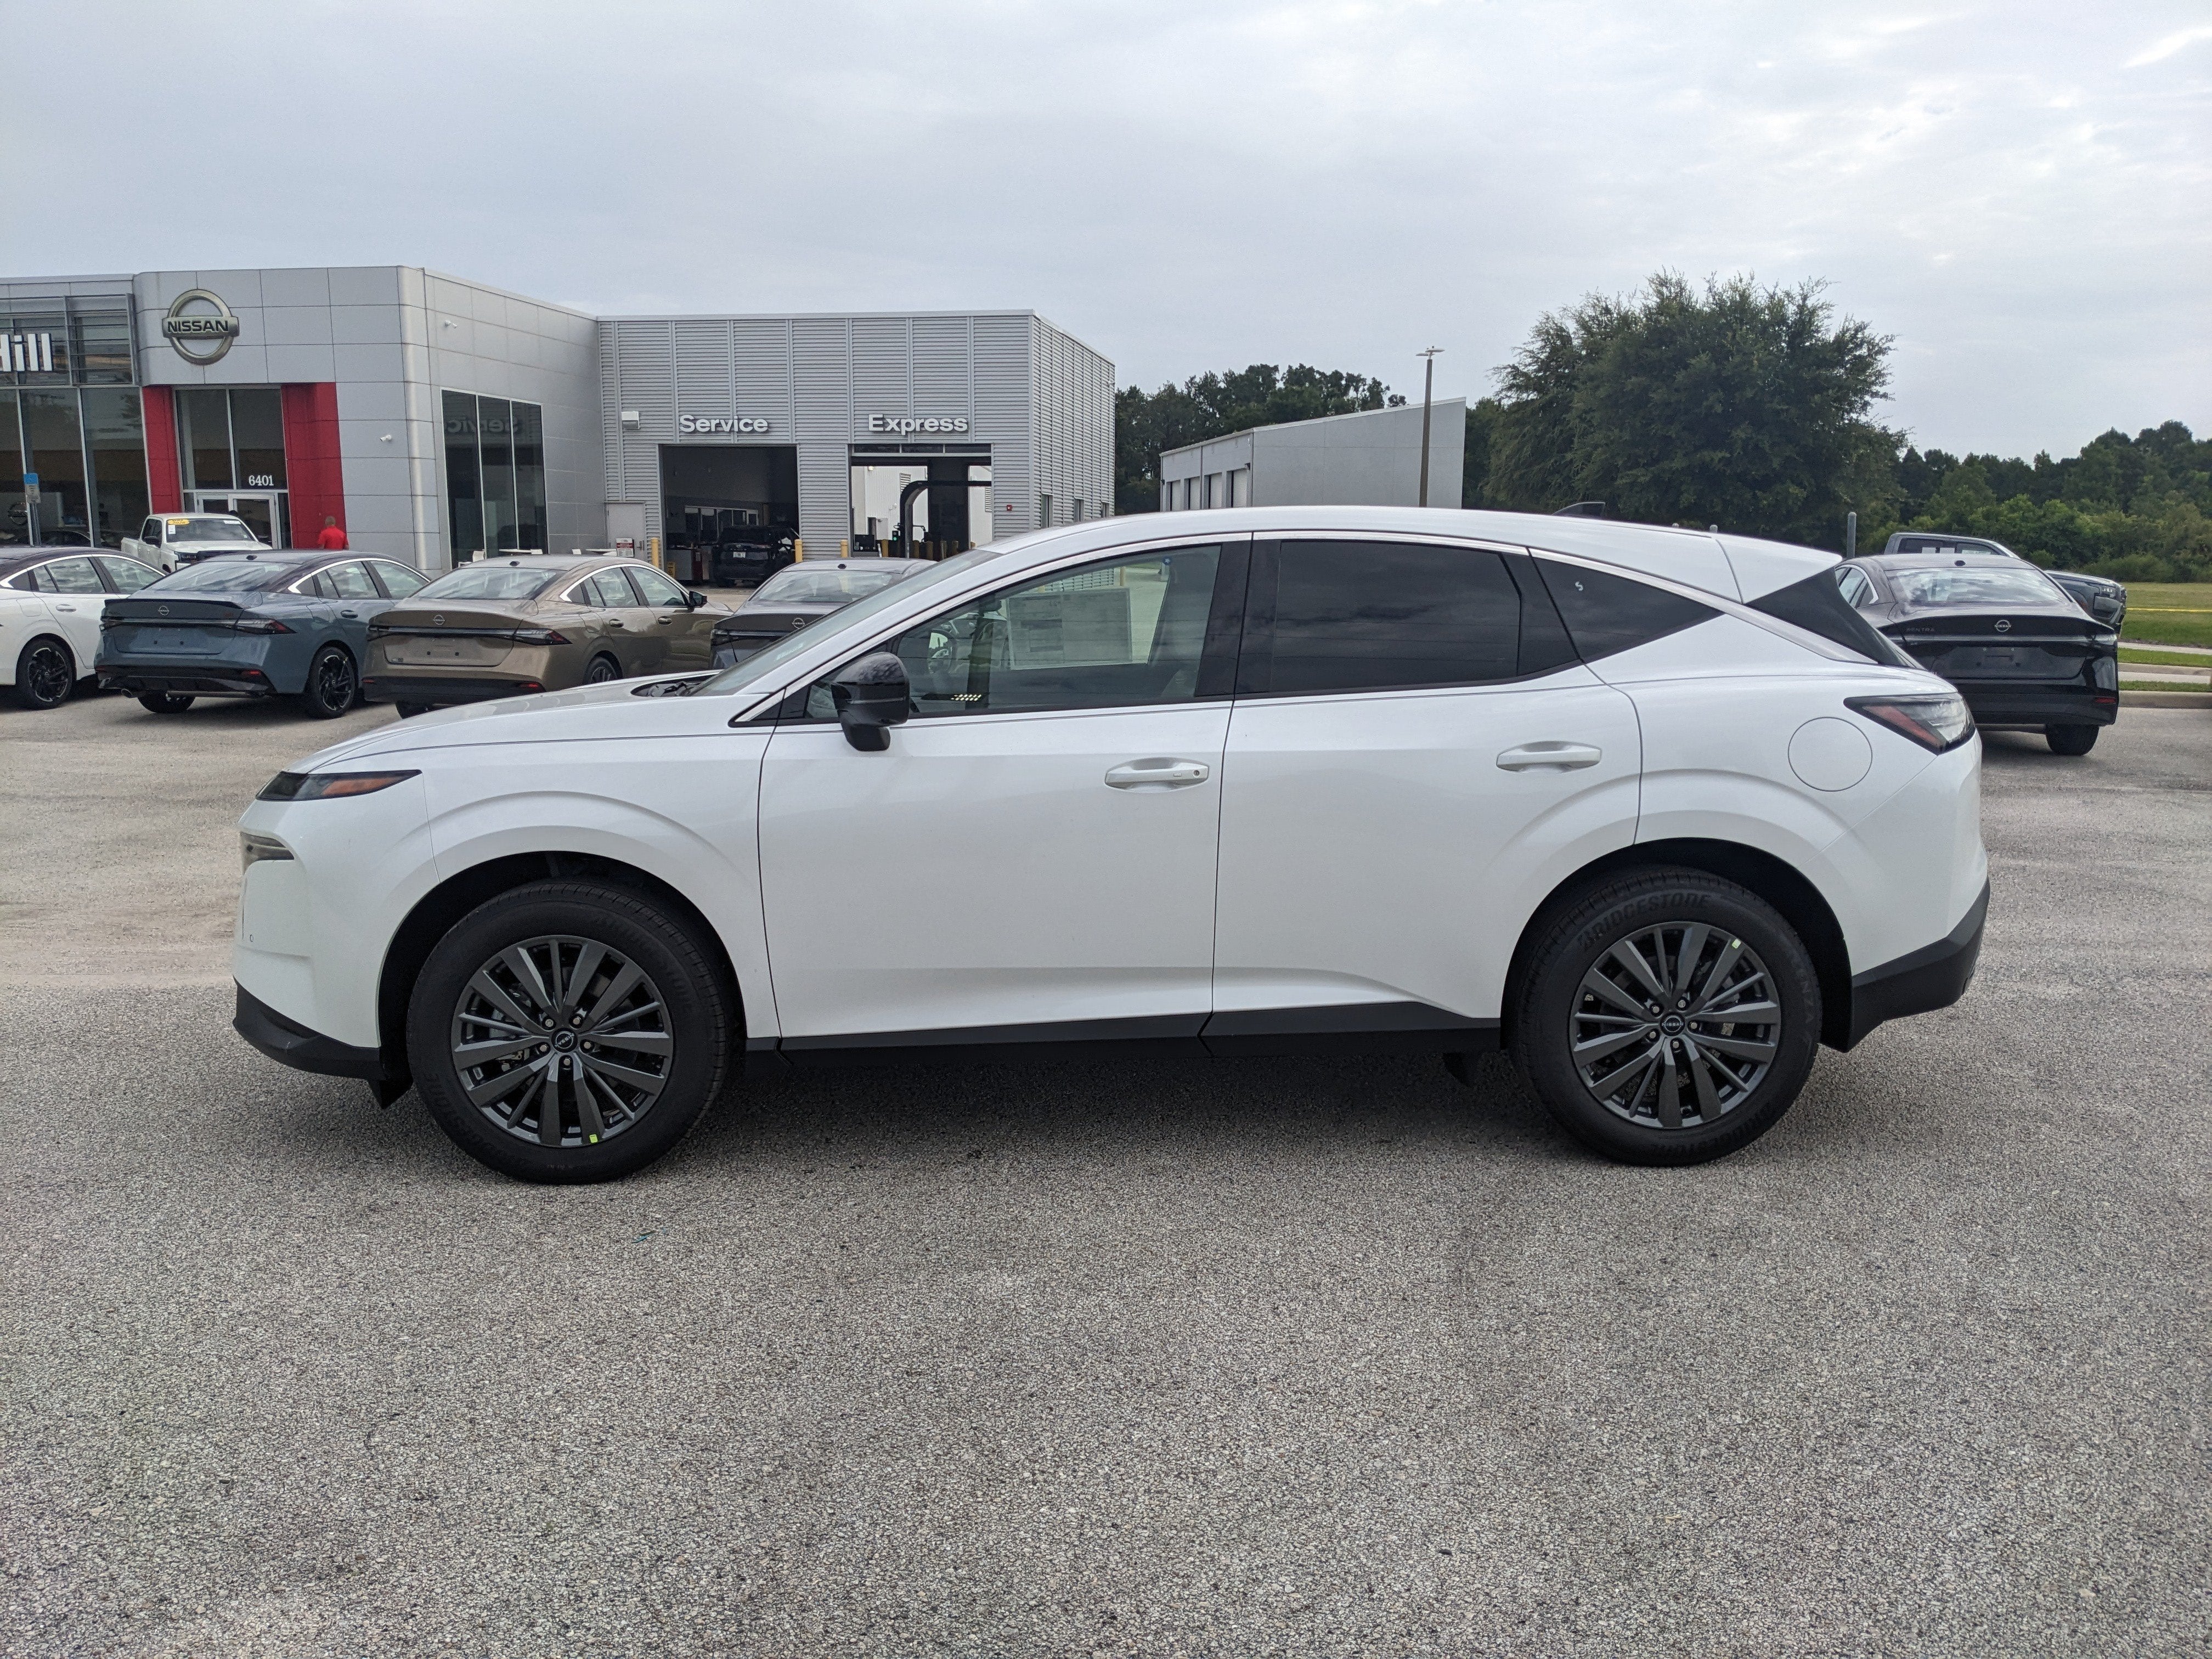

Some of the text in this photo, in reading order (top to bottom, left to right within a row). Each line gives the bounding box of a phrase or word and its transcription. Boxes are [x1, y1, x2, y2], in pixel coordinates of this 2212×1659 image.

[167, 320, 229, 332] NISSAN
[679, 414, 968, 436] Service Express
[249, 475, 274, 486] 6401
